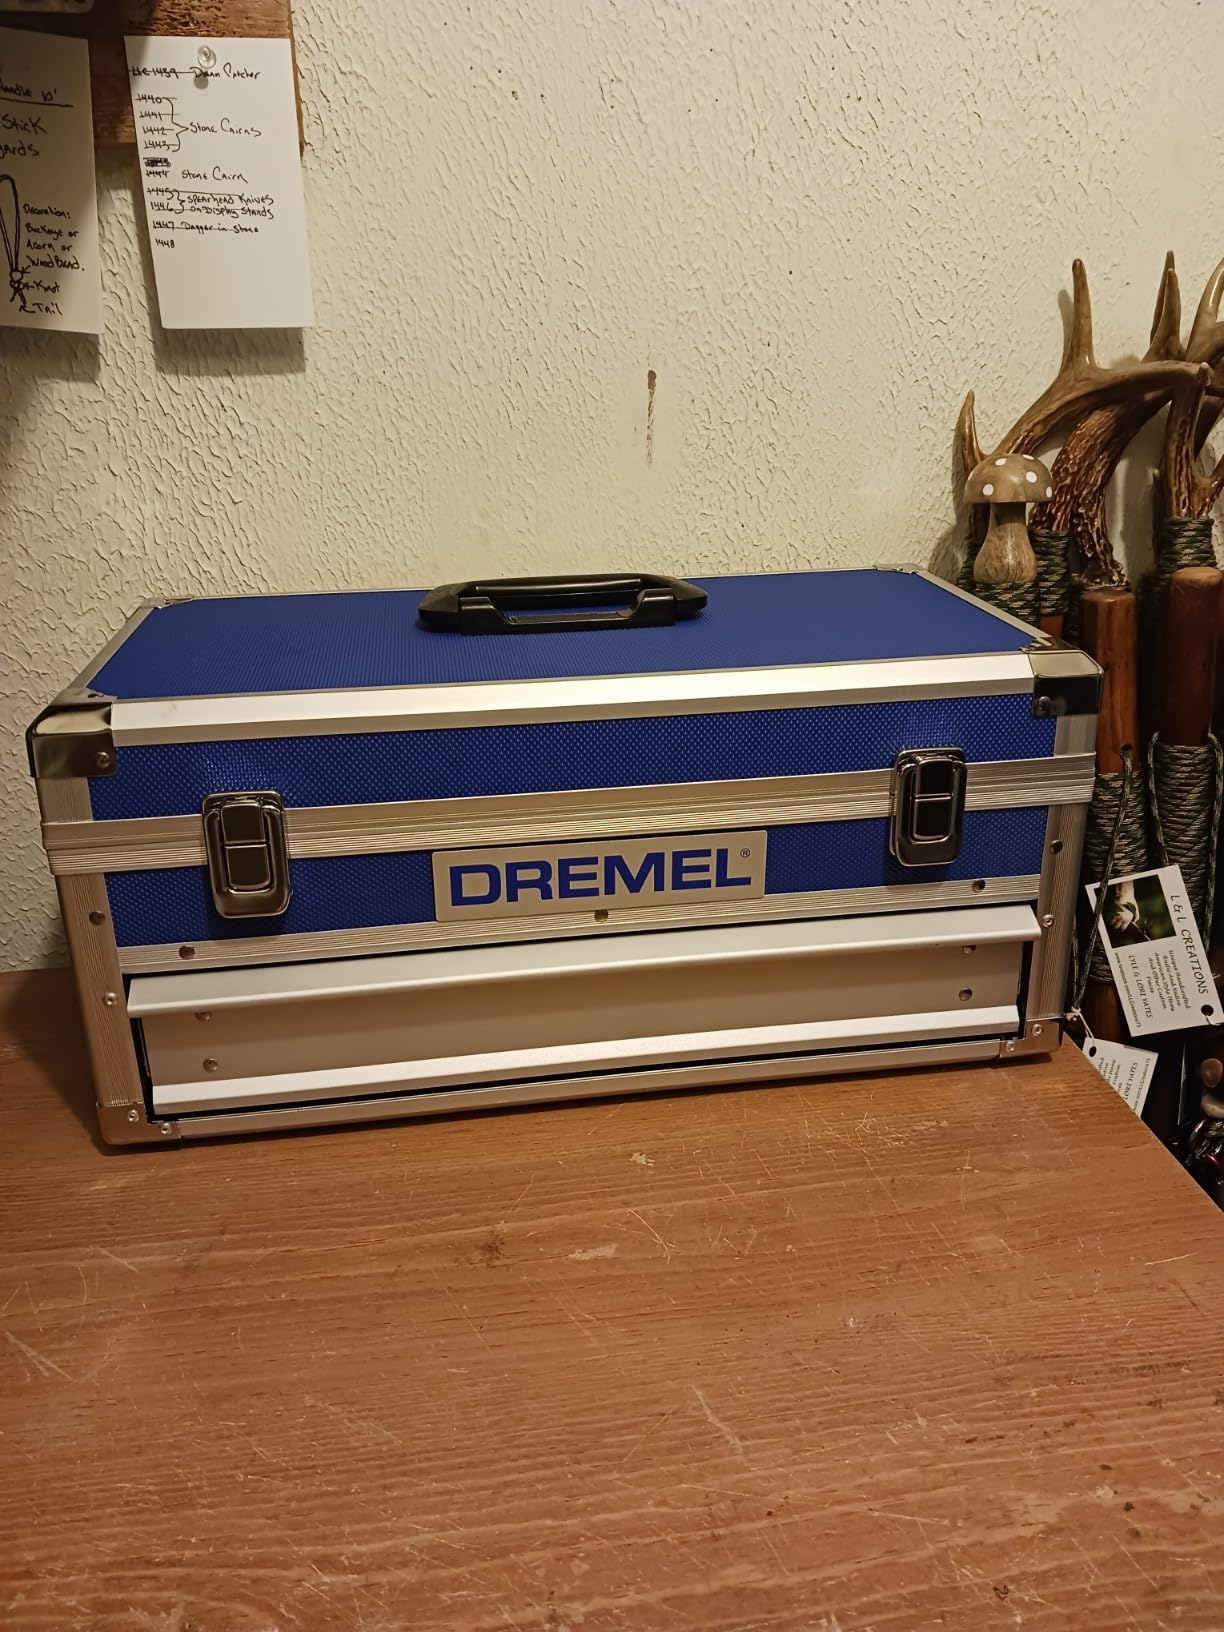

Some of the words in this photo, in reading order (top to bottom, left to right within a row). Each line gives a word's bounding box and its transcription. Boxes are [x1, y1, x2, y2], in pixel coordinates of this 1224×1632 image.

[136, 93, 163, 104] 1440
[142, 126, 168, 136] 1442
[190, 122, 217, 134] Stone
[220, 117, 262, 138] Cairns
[143, 140, 171, 151] 1443
[181, 169, 208, 180] Stone
[212, 166, 249, 184] Cairn
[238, 193, 274, 206] Knives
[23, 203, 71, 220] Decoration:
[68, 230, 80, 238] or
[152, 220, 175, 231] 1447
[180, 221, 214, 235] Dagger
[217, 222, 228, 232] in
[26, 239, 56, 253] Acorn
[61, 244, 73, 252] or
[155, 238, 176, 249] 1448
[33, 280, 60, 294] Knot
[32, 302, 63, 316] Tail
[1173, 904, 1184, 915] &
[1178, 916, 1187, 924] L
[1181, 929, 1209, 995] CREATIONS
[1129, 955, 1138, 970] LYLE
[1136, 979, 1146, 996] LORI
[1142, 998, 1152, 1018] YATES
